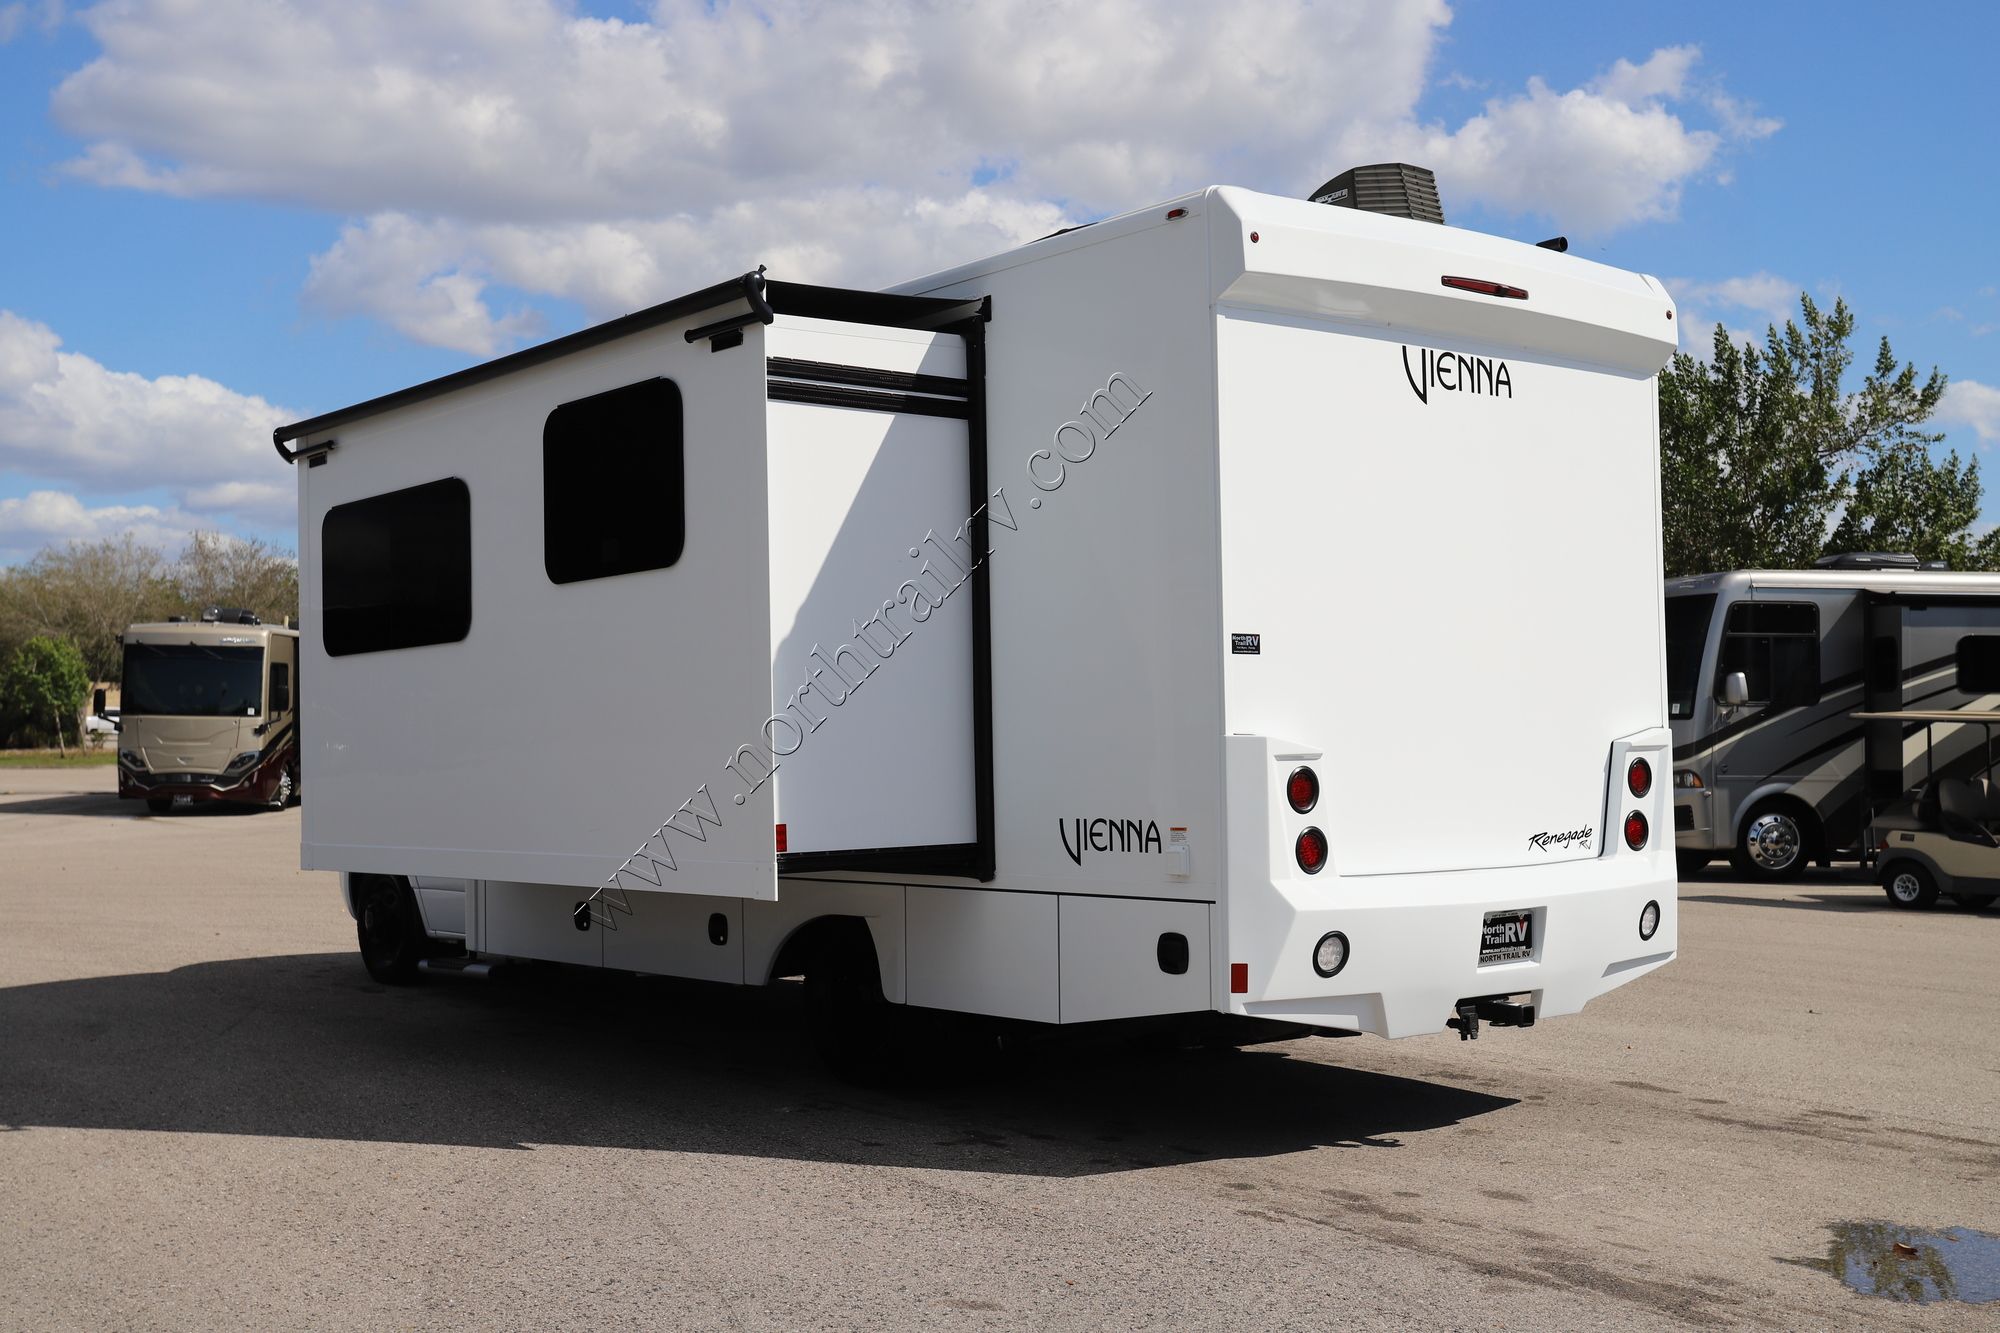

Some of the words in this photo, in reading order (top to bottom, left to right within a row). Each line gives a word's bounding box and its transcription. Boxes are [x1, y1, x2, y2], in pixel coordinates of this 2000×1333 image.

[1402, 345, 1512, 405] VIENNA
[1246, 635, 1259, 646] RV
[1059, 818, 1162, 867] VIENNA
[1528, 824, 1593, 852] Renegade
[1485, 933, 1505, 945] Trail
[1505, 922, 1528, 943] RV
[1480, 954, 1501, 963] NORTH
[1502, 951, 1521, 960] TRAIL
[1522, 950, 1531, 958] RV
